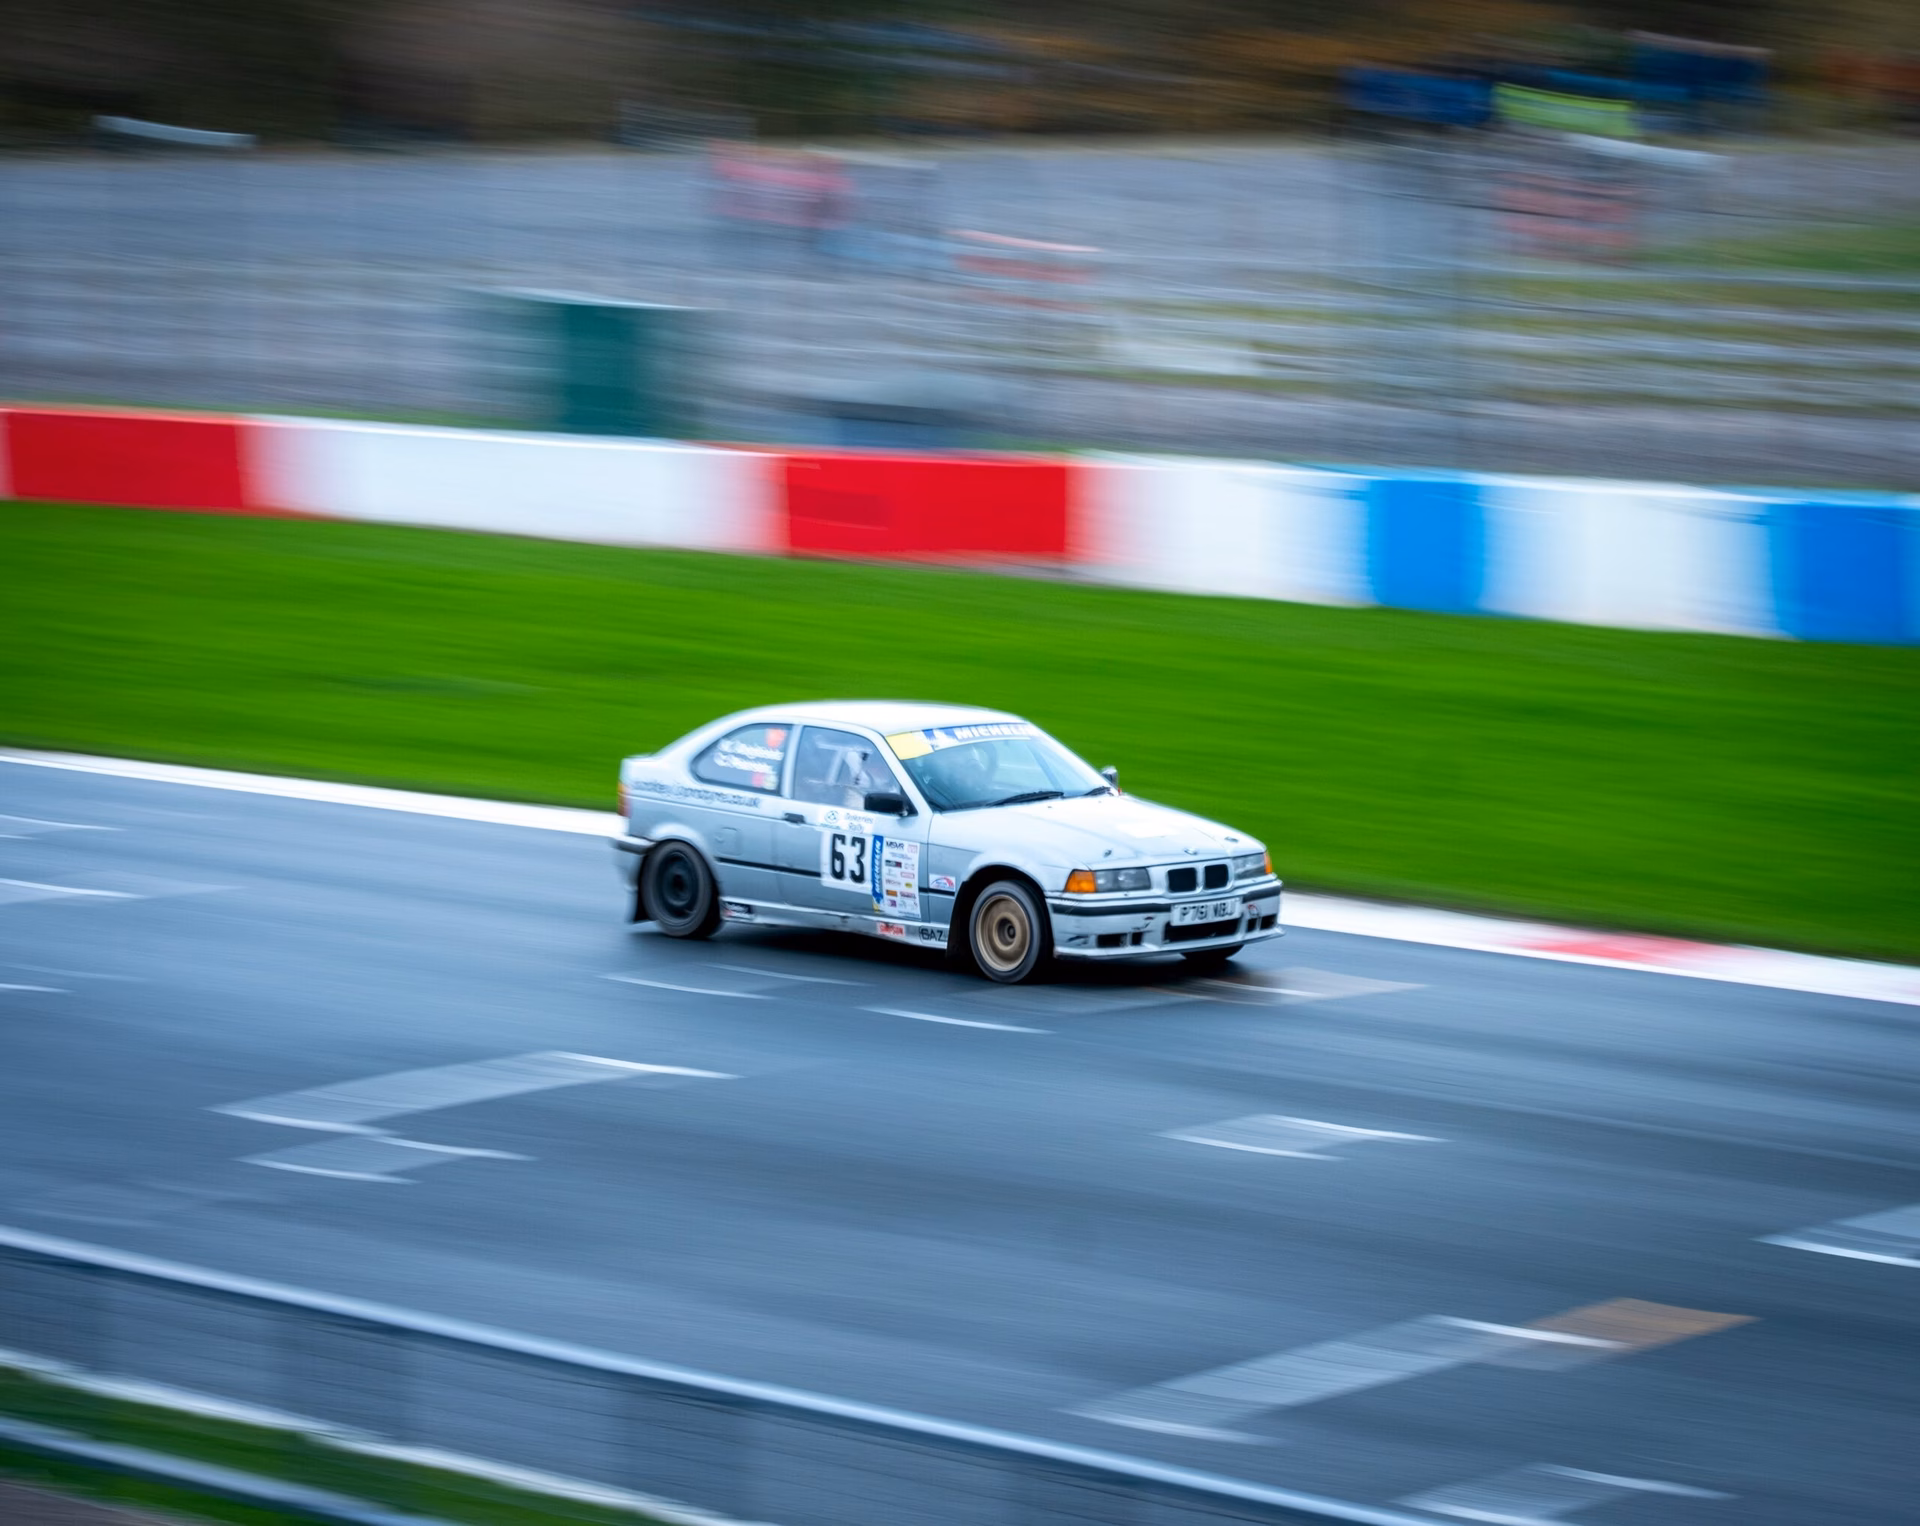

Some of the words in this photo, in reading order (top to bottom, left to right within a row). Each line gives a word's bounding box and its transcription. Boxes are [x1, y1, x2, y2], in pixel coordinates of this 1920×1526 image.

[886, 841, 904, 850] MSVR
[831, 833, 865, 884] 63
[874, 840, 882, 894] MICHELIN
[880, 923, 903, 935] SIMPSON
[921, 928, 943, 941] GAZ
